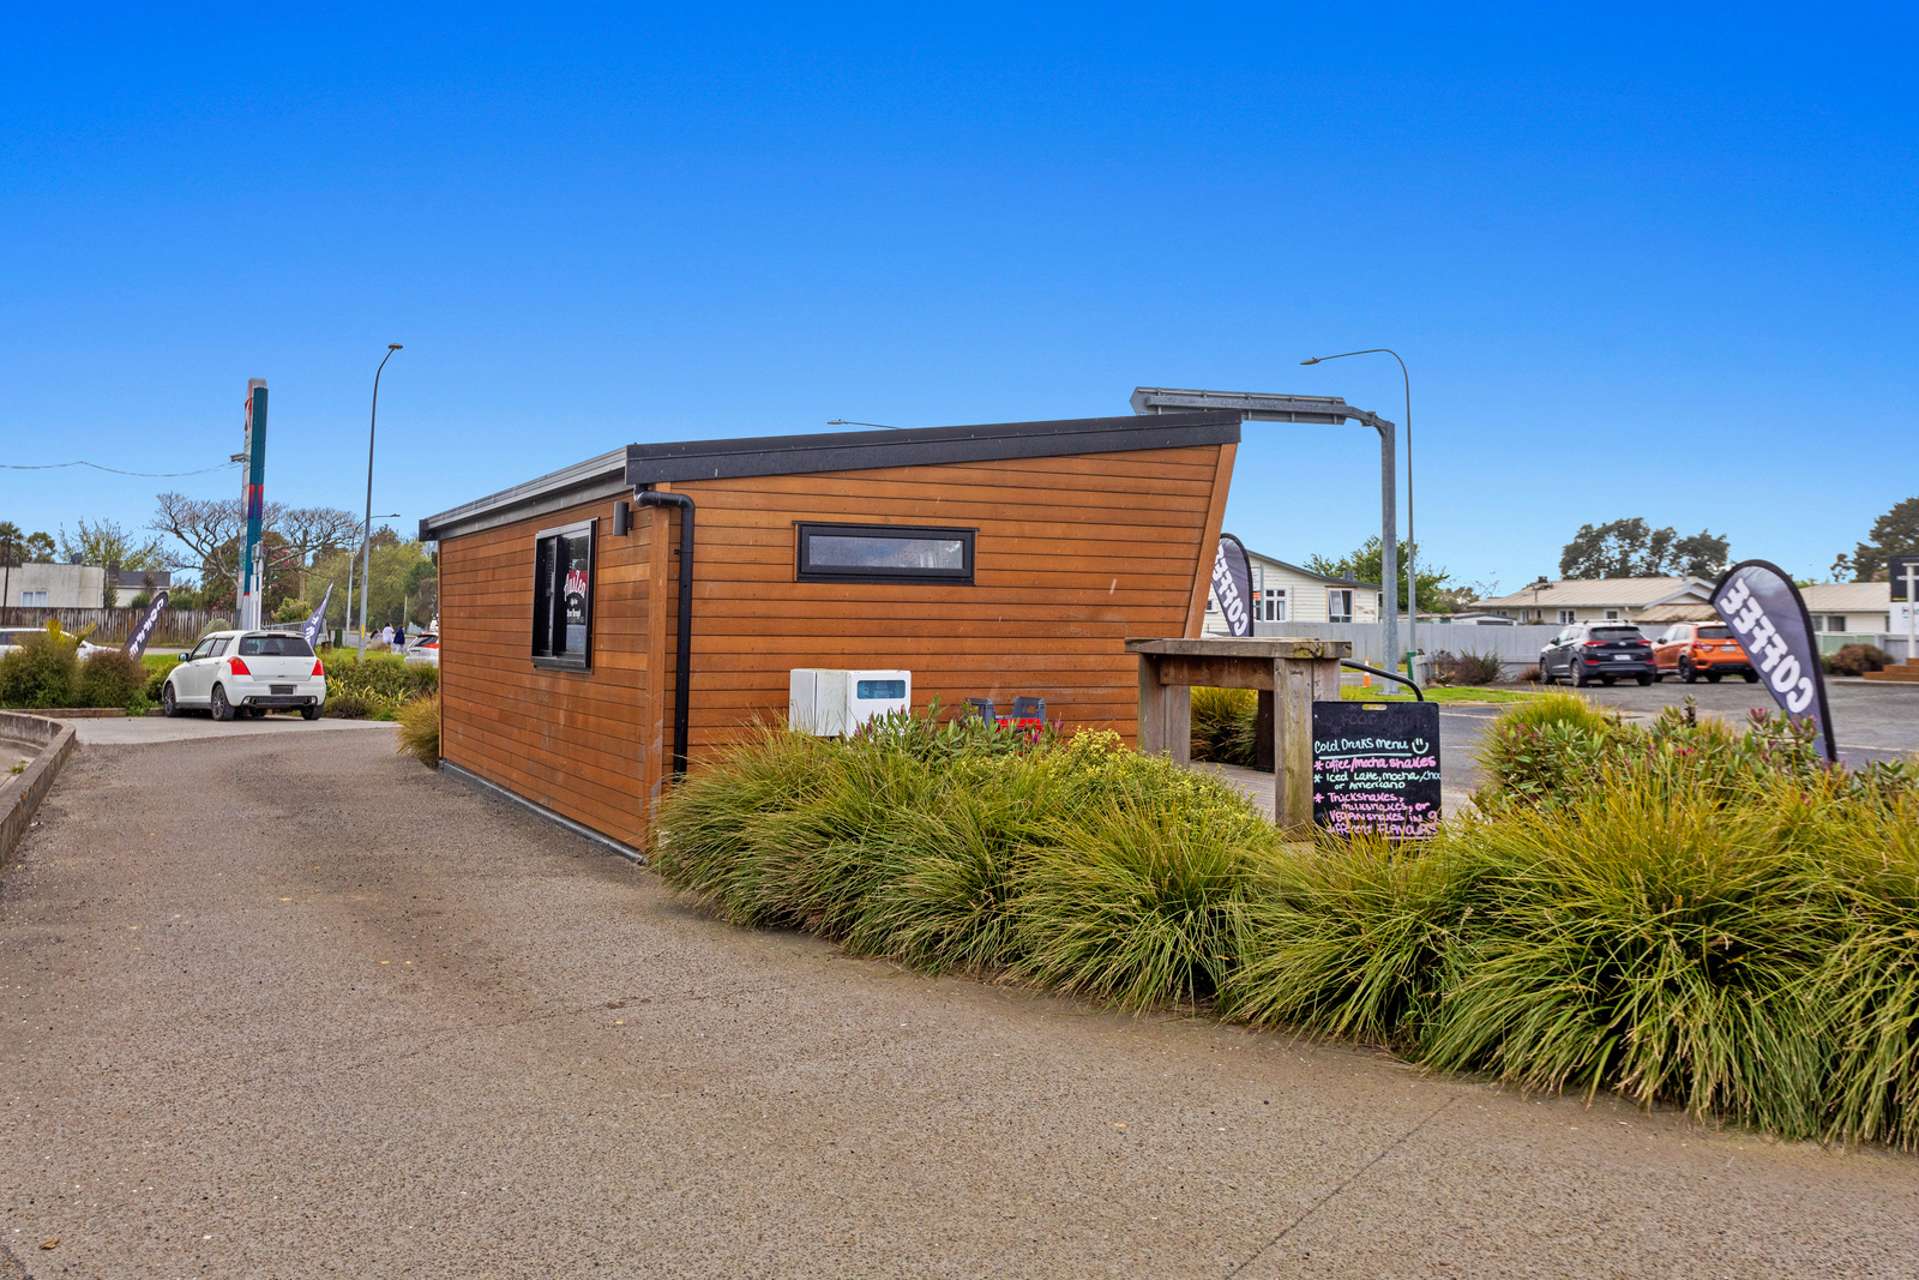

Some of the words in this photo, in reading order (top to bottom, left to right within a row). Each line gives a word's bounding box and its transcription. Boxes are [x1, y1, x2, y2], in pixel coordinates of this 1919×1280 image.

[129, 598, 164, 657] COFFE
[1314, 740, 1340, 754] Cold
[1389, 756, 1436, 769] shakes
[1326, 771, 1348, 782] Iced
[1415, 802, 1431, 811] or
